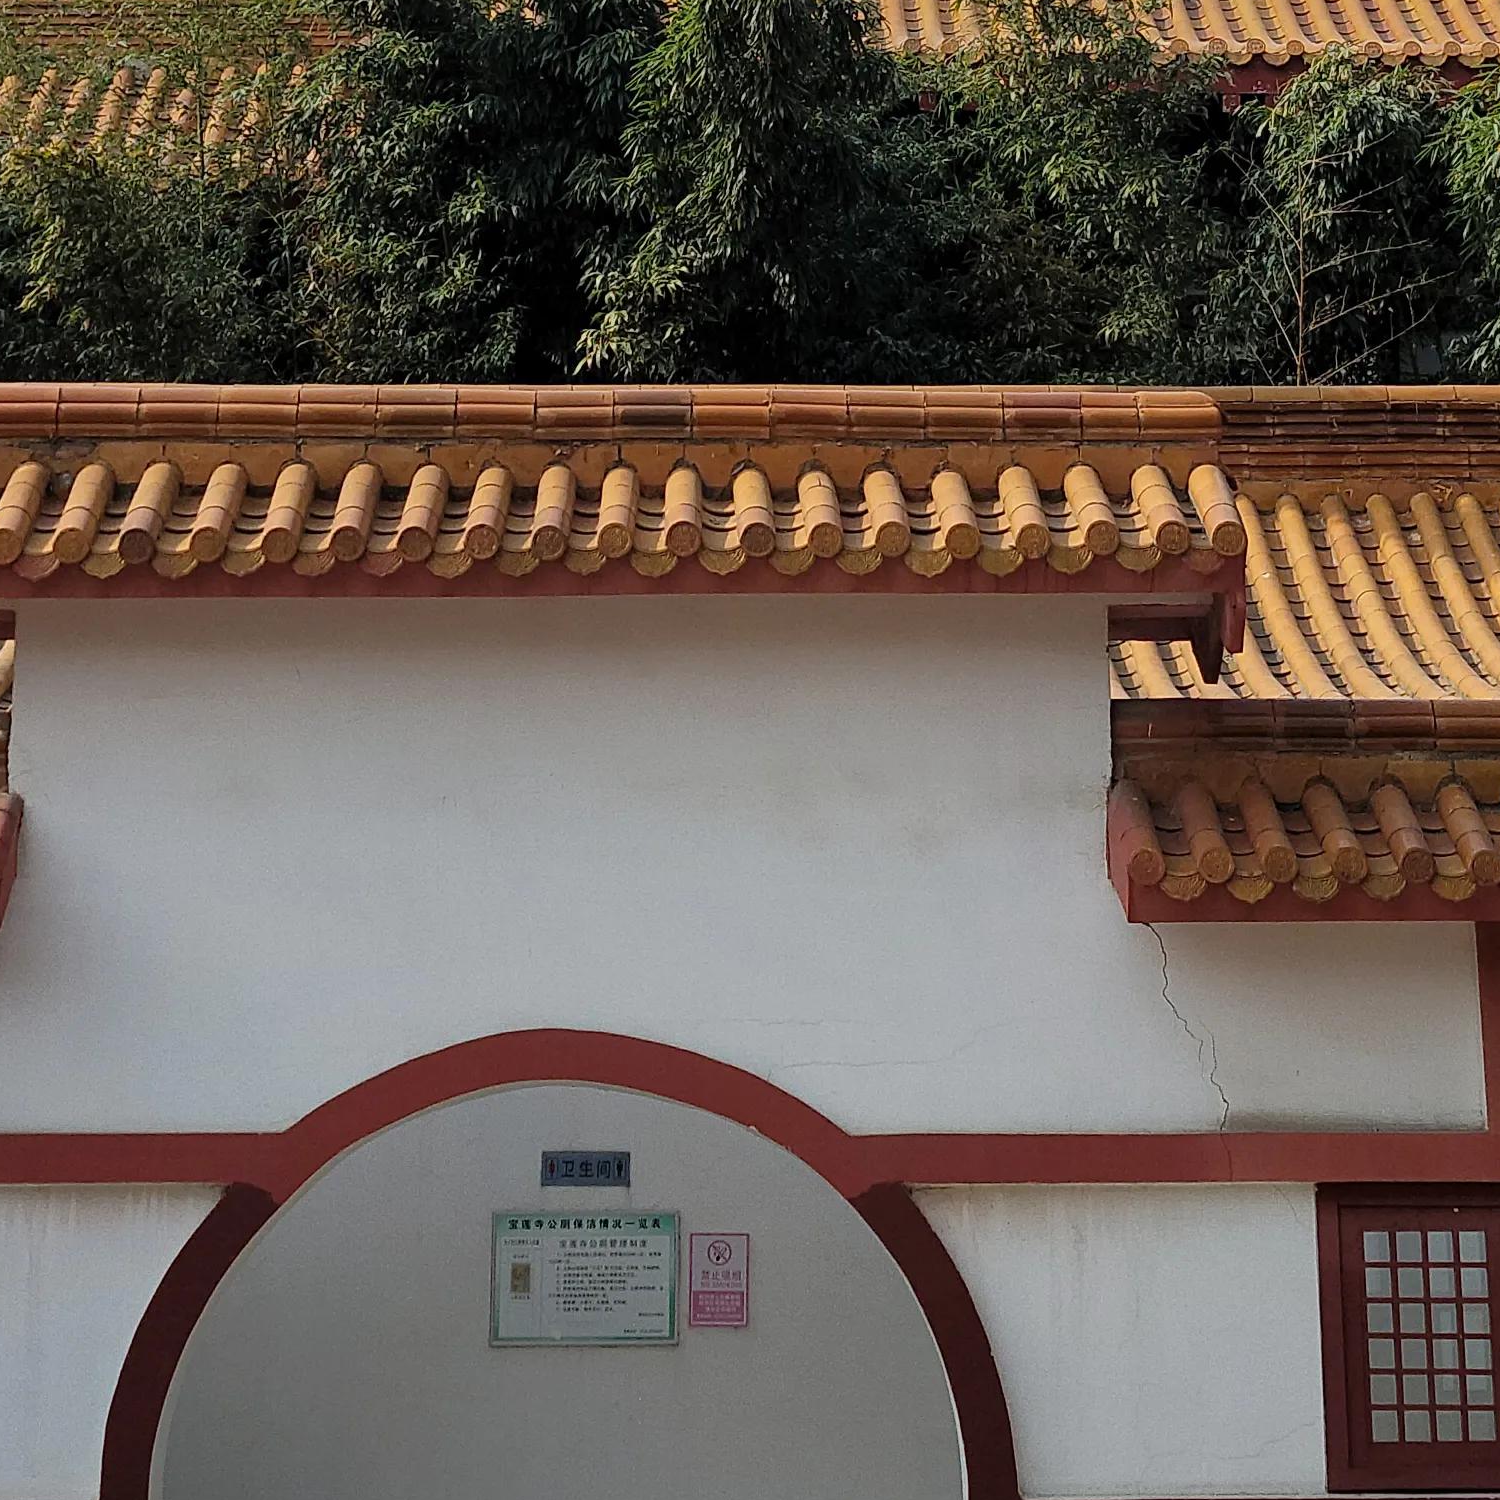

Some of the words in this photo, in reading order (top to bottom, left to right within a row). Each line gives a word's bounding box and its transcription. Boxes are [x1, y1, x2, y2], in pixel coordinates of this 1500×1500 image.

[561, 1159, 612, 1179] 卫生间
[508, 1218, 662, 1230] 宝莲寺公厕保洁情况一览表
